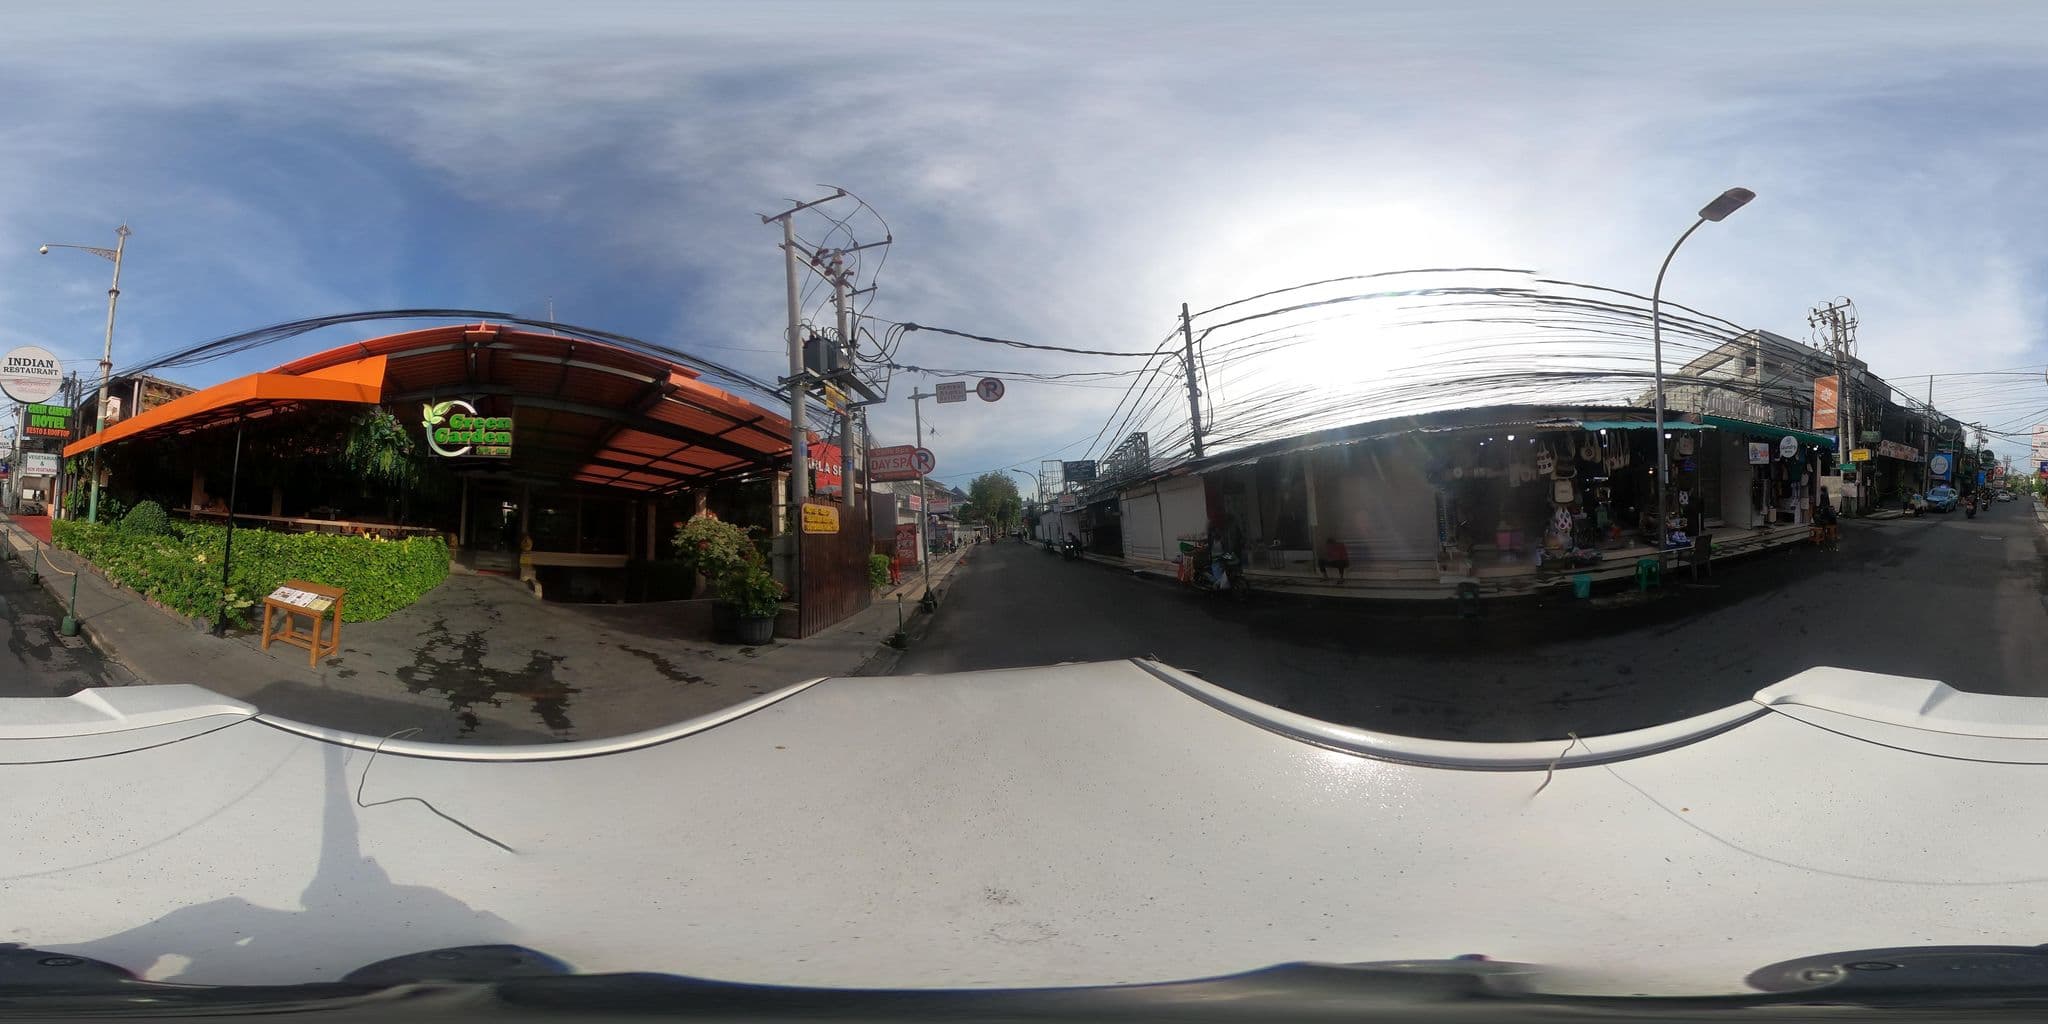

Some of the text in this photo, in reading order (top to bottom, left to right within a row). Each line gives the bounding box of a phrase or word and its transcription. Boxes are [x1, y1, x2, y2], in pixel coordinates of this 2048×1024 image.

[8, 357, 55, 368] INDIAN
[3, 367, 58, 375] RESTAURANT
[32, 415, 65, 429] HOTEL
[449, 413, 512, 430] Green
[48, 428, 70, 437] ROOFTOP
[434, 427, 512, 444] Garden
[871, 459, 891, 471] DAY
